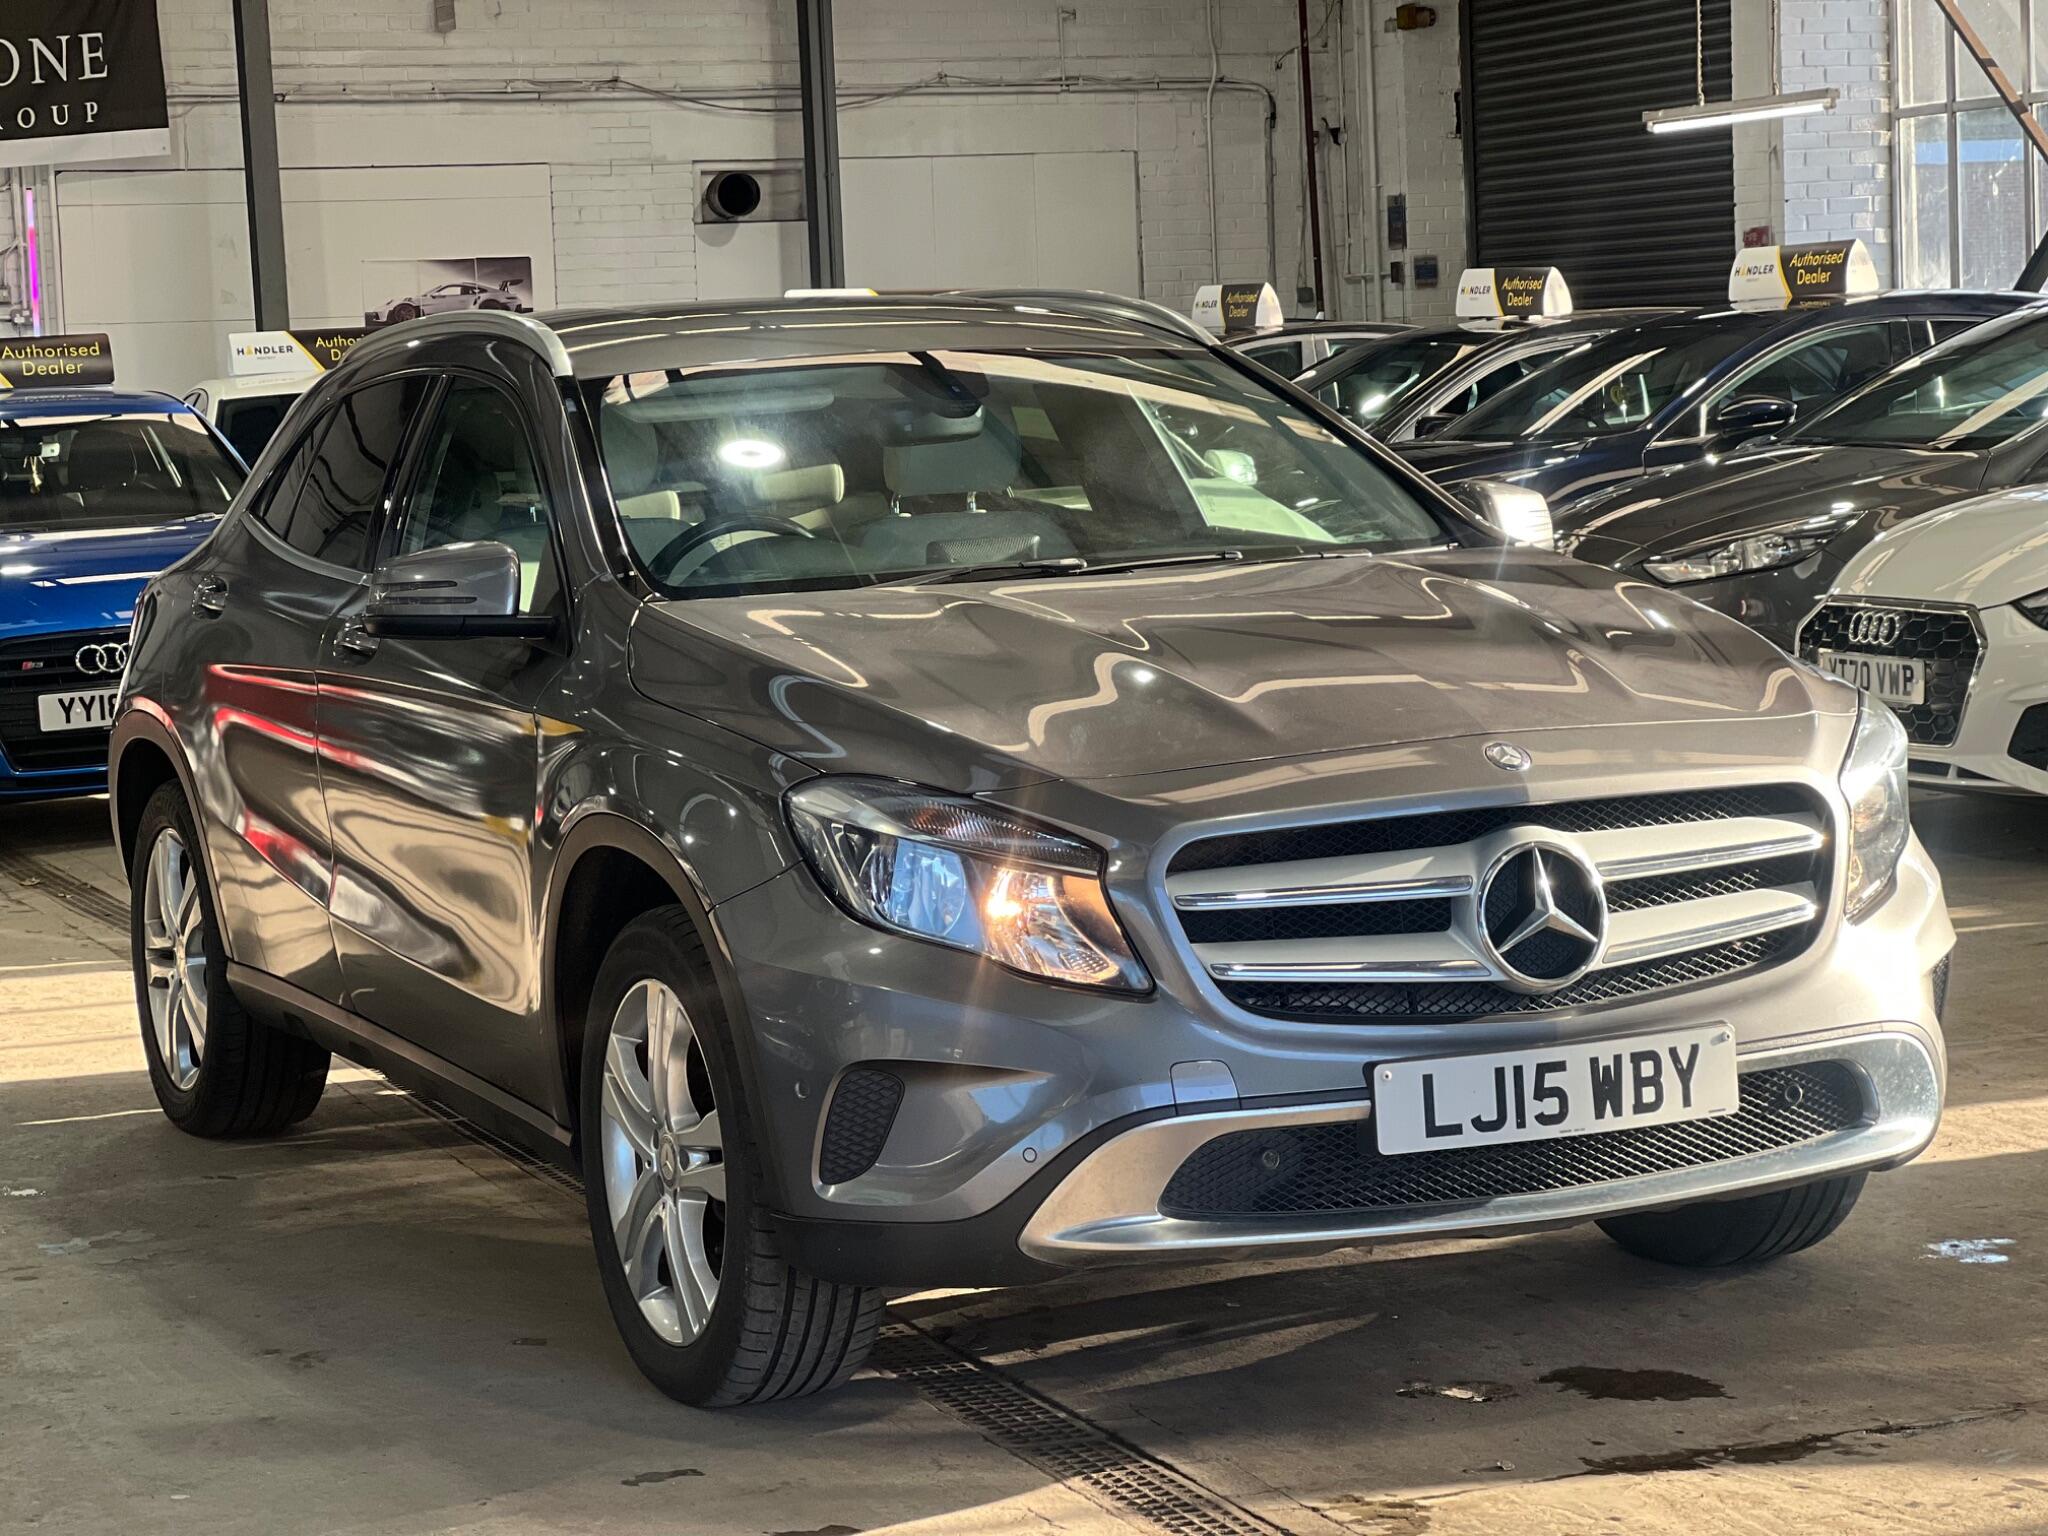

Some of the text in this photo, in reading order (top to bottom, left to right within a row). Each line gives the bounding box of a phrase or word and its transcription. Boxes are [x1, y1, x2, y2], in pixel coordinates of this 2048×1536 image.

[0, 101, 98, 130] OUP
[1789, 248, 1847, 268] Authorised
[1502, 275, 1545, 290] Authorised
[1797, 267, 1832, 285] Dealer
[1507, 291, 1534, 306] Dealer
[1, 341, 100, 360] Authorised
[22, 358, 84, 376] Dealer
[1422, 1042, 1700, 1138] LJ15 WBY
